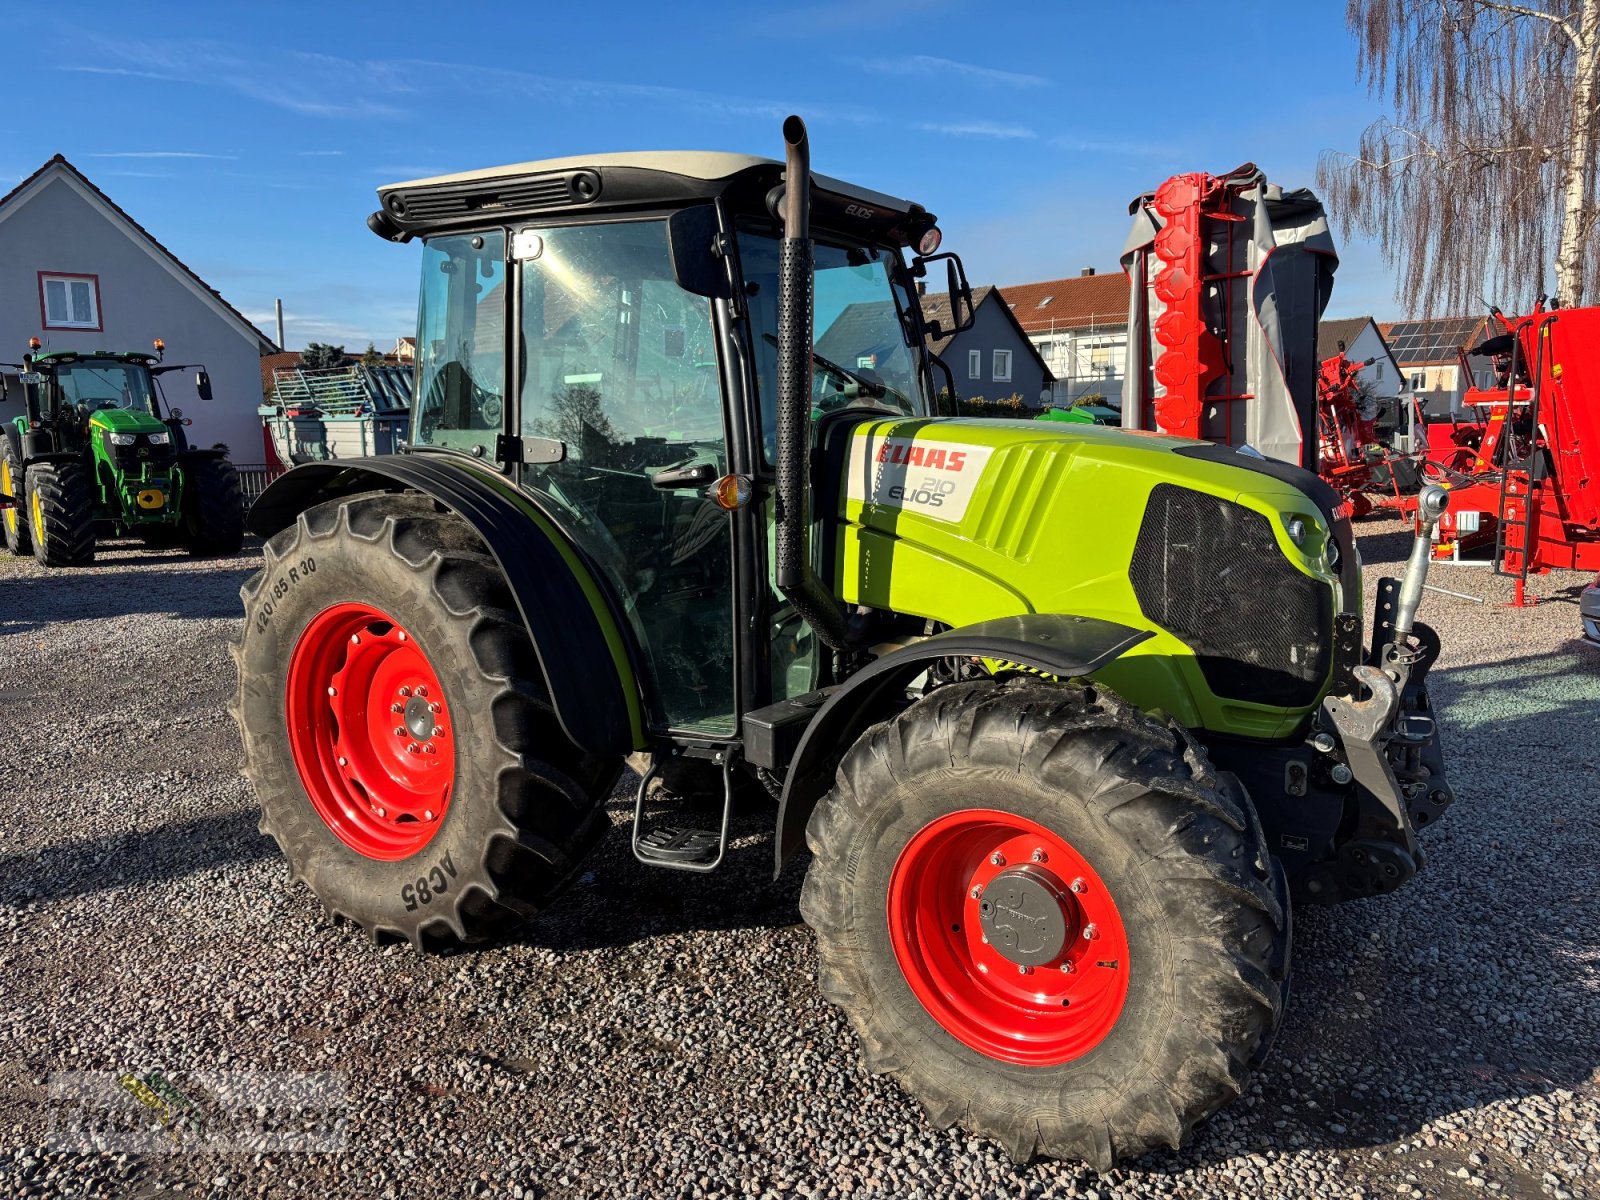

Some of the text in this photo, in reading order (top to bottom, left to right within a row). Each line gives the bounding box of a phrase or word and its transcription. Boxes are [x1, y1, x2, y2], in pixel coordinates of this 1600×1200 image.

[845, 204, 874, 219] ELIOS
[875, 443, 967, 472] CLAAS
[888, 485, 945, 507] ELIOS
[920, 477, 955, 495] 210
[288, 567, 300, 584] R
[300, 557, 316, 576] 30
[401, 848, 457, 912] AC85
